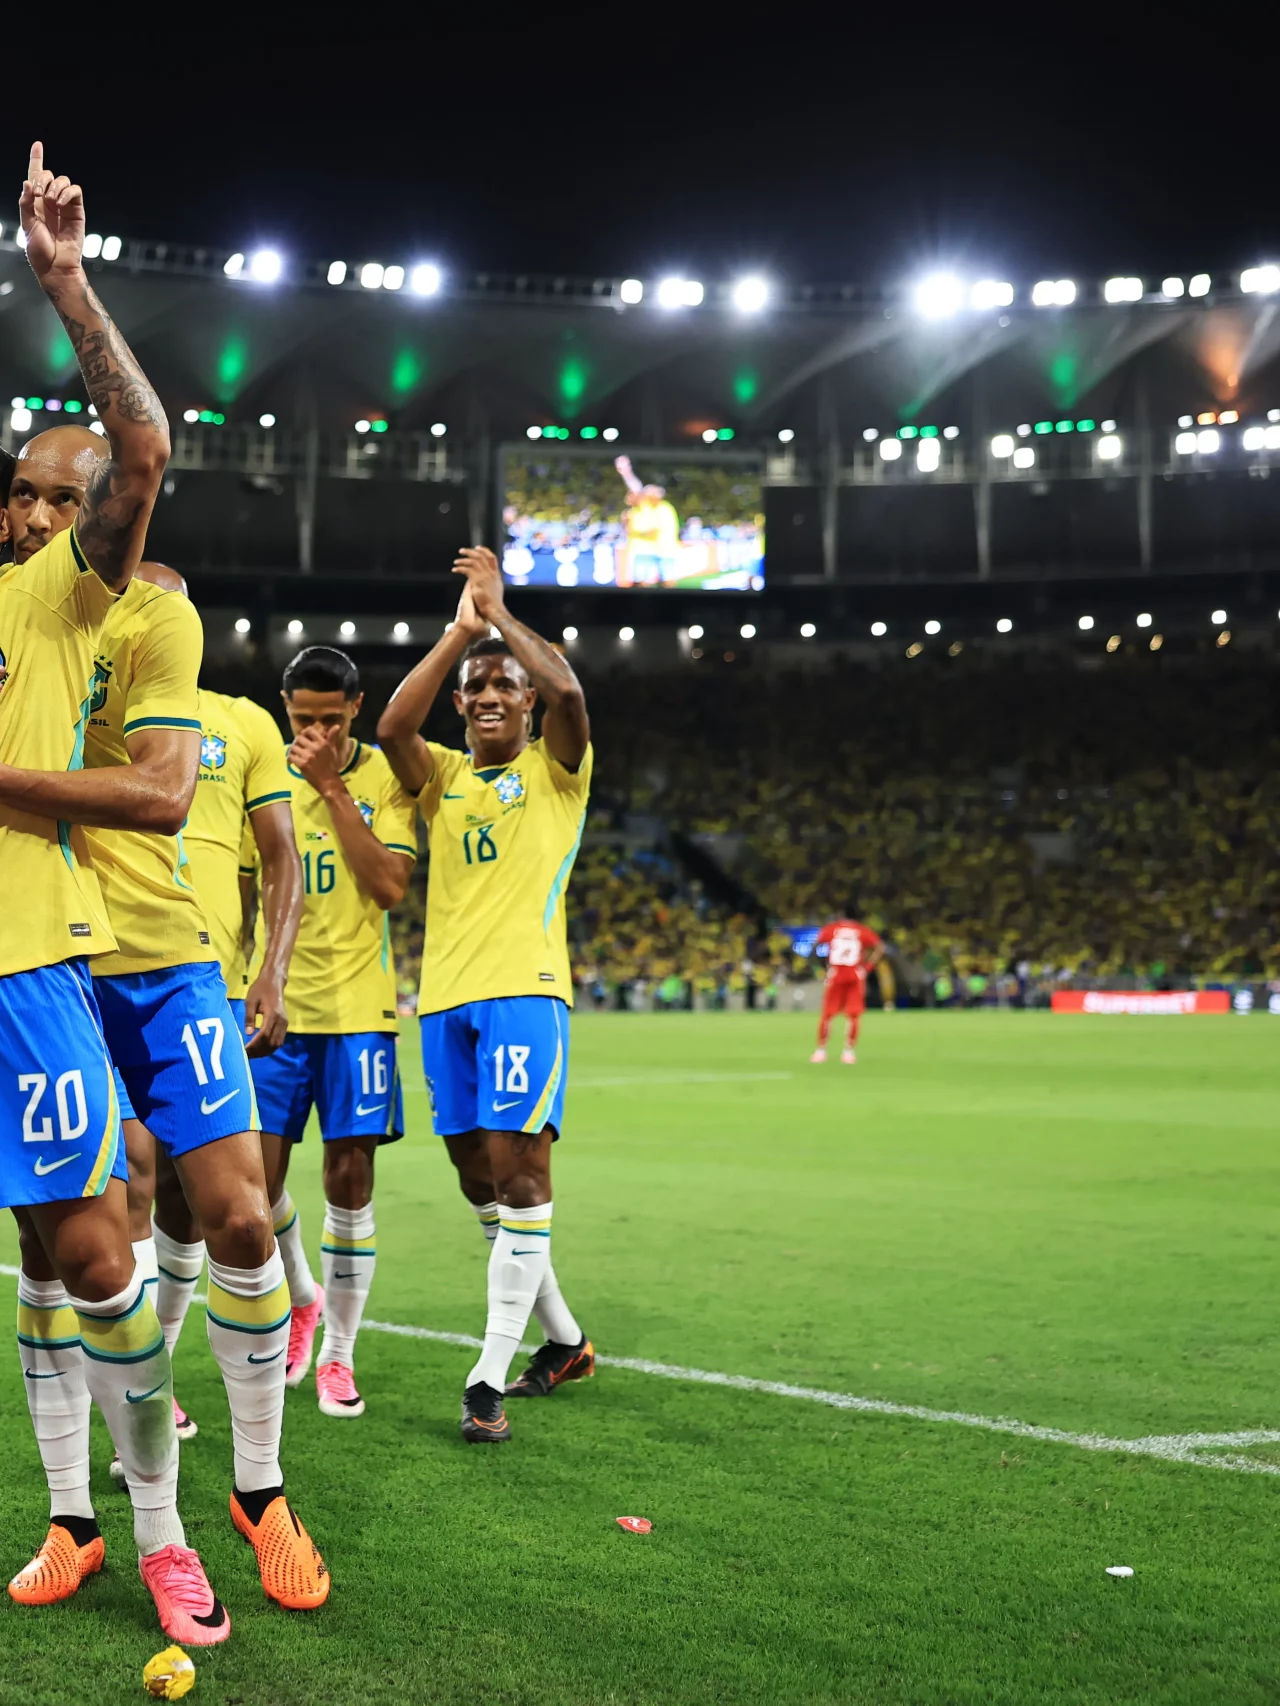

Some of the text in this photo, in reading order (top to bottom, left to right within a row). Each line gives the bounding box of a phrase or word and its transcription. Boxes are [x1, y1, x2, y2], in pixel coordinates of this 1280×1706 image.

[463, 823, 497, 864] 18
[303, 850, 335, 895] 16
[181, 1018, 225, 1086] 17
[358, 1049, 388, 1095] 16
[493, 1045, 531, 1094] 18
[18, 1069, 89, 1143] 20
